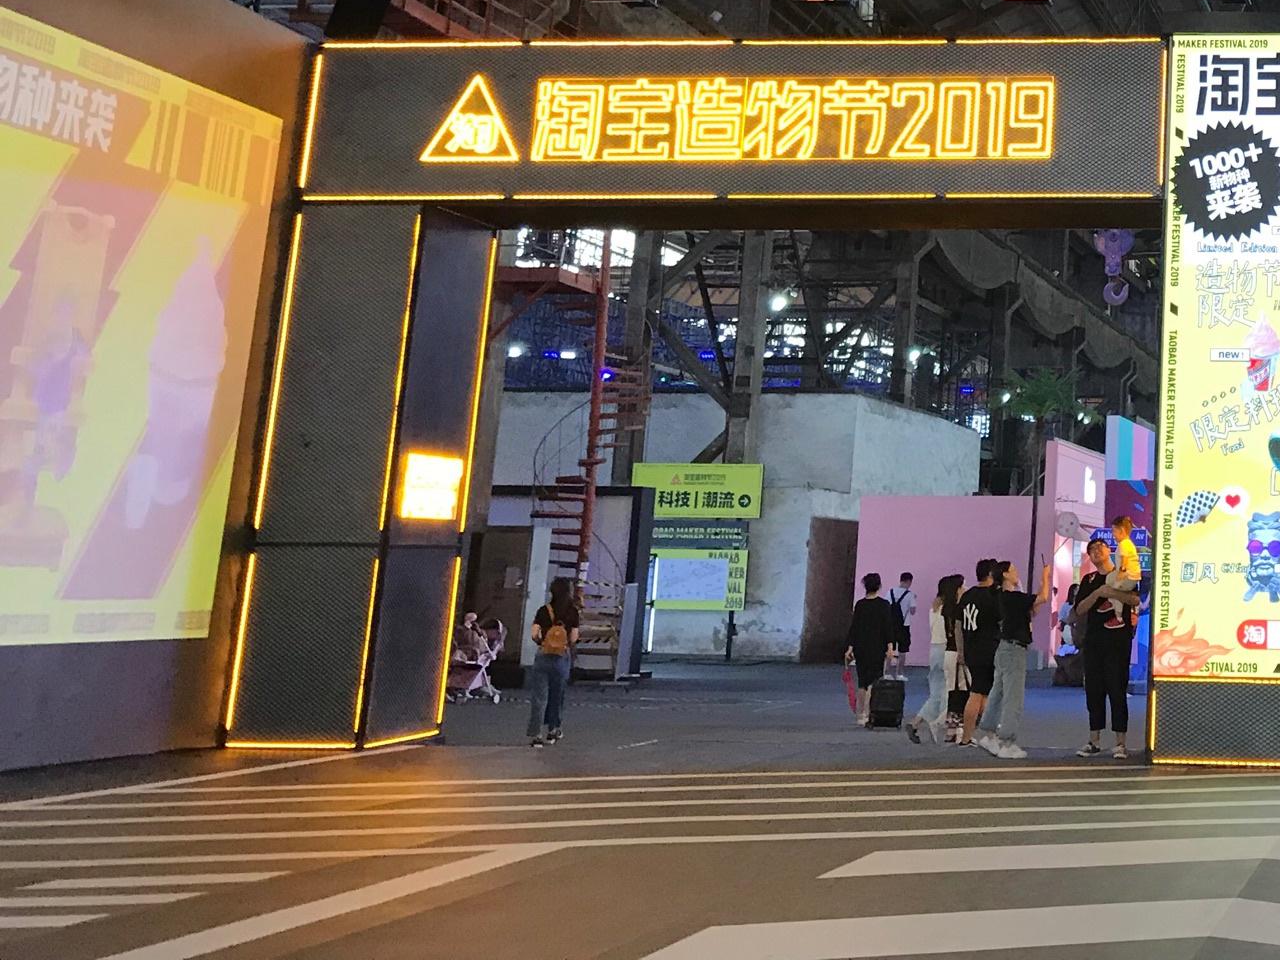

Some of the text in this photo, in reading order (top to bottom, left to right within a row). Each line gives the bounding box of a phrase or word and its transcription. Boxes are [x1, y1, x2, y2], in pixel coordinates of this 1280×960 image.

[1178, 39, 1268, 48] MAKER FESTIVAL 2019
[1175, 54, 1186, 113] FESTIVAL 2019
[531, 77, 1055, 159] 淘宝造物节2019
[1189, 142, 1263, 179] 1000+
[1208, 168, 1251, 191] 新物种
[1205, 181, 1263, 221] 来袭
[1171, 222, 1181, 267] FESTIVAL
[1197, 242, 1279, 253] Limited Edition
[1170, 267, 1180, 287] 2019
[1197, 294, 1256, 329] 限定
[1165, 329, 1179, 470] TAOBAO MAKER FESTIVAL 2019
[1220, 438, 1245, 456] Food
[658, 490, 735, 508] 科技 潮流
[1159, 513, 1172, 632] TAOBAO MAKER FESTIVA
[1181, 561, 1219, 584] 国风
[1237, 662, 1258, 673] 2019
